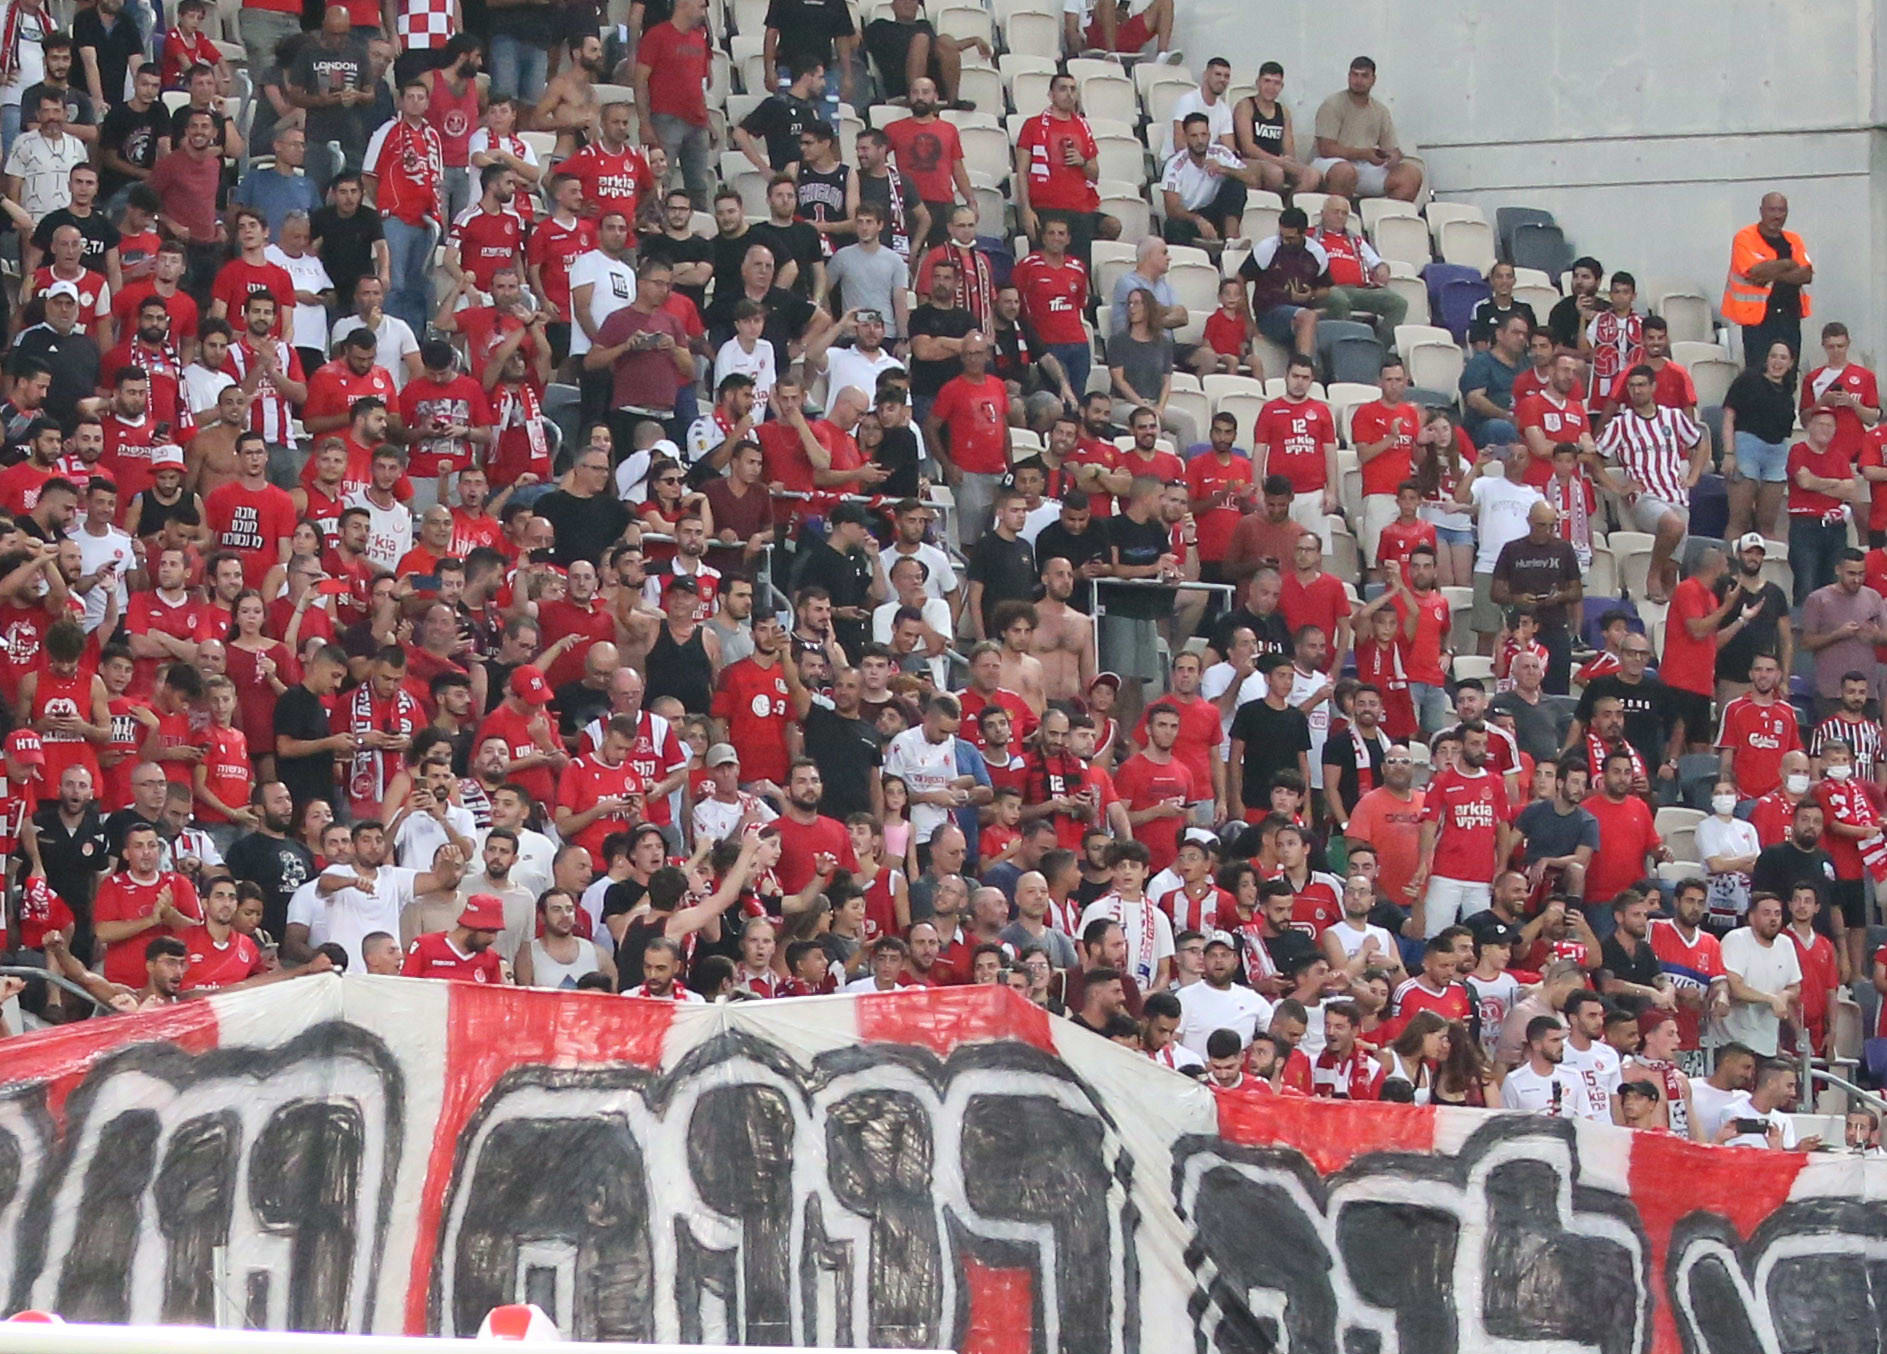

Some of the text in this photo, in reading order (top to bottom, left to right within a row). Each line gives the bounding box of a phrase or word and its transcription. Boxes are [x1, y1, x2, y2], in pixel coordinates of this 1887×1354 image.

[313, 61, 359, 73] LONDON
[1254, 122, 1283, 141] VANS
[597, 175, 635, 188] arkia
[1291, 418, 1307, 435] 12
[1515, 558, 1548, 572] Hurley
[16, 738, 41, 751] HTA
[1454, 801, 1493, 817] arkia
[1456, 814, 1493, 830] ארקיע
